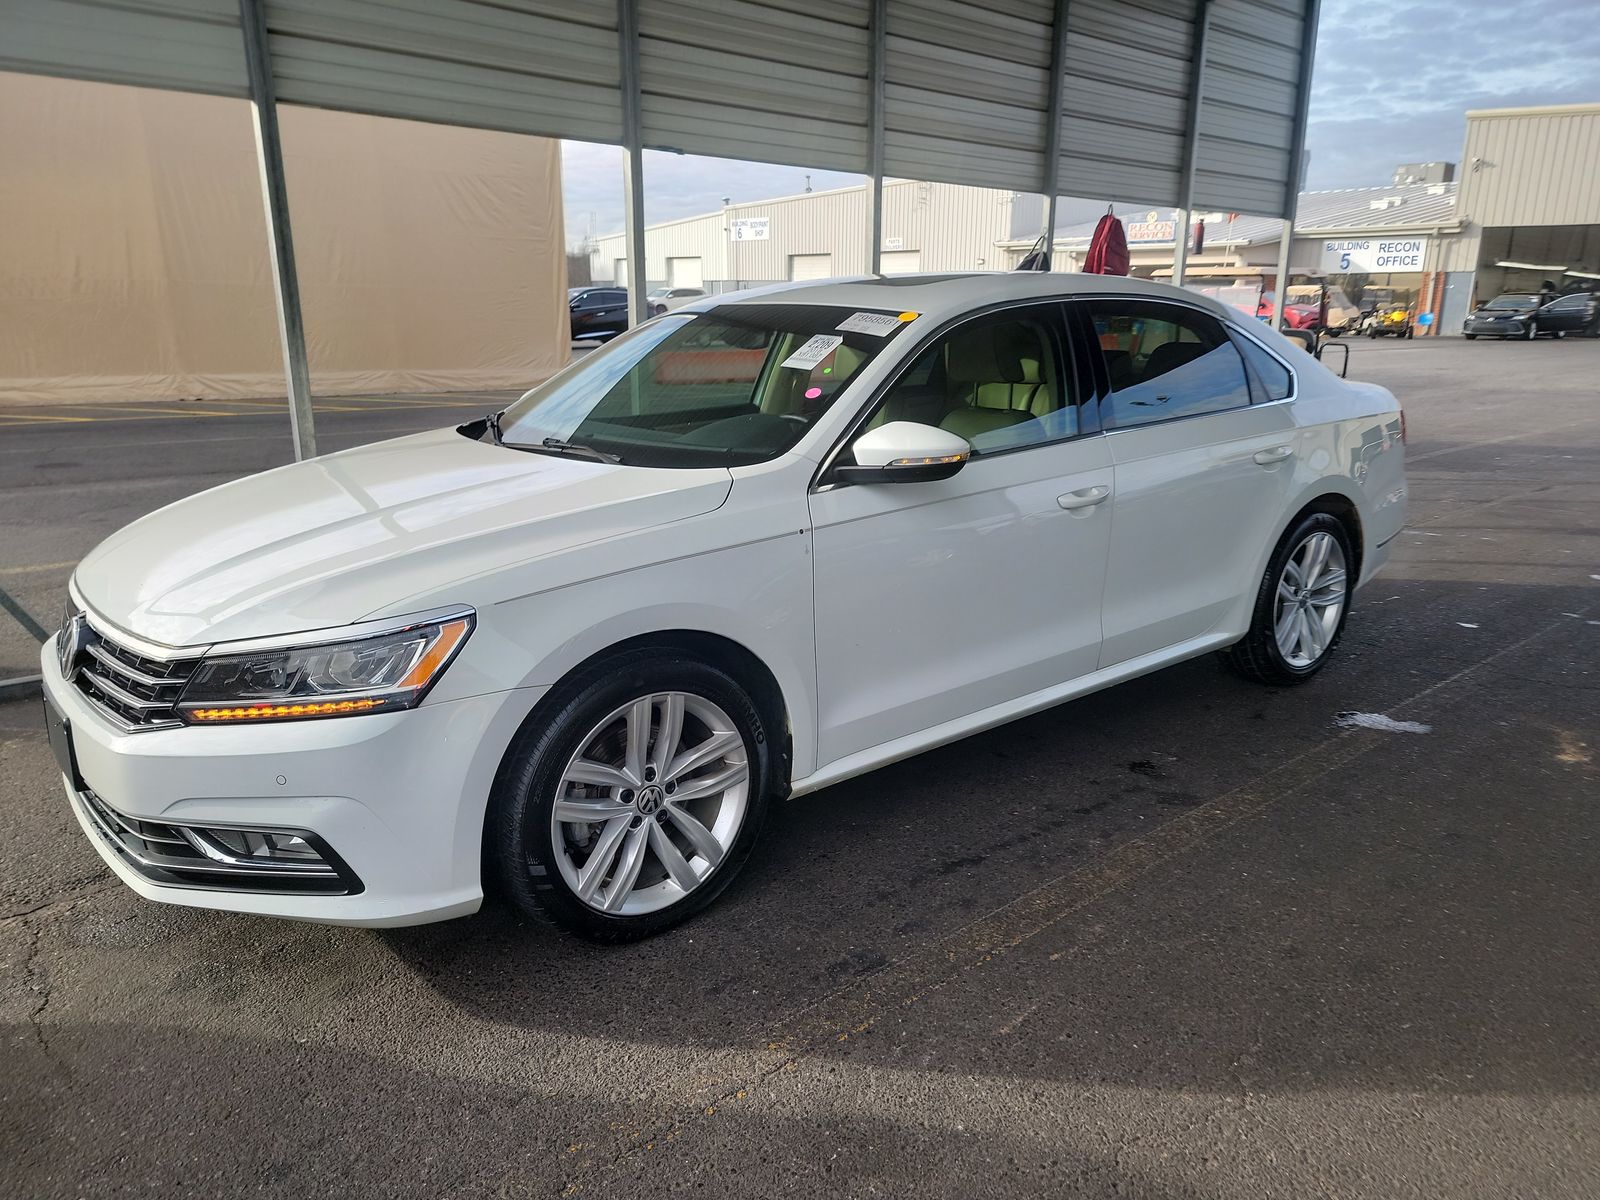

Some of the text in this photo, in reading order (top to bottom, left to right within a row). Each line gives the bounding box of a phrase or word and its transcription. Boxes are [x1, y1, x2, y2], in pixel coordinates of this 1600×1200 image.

[1129, 222, 1174, 232] RECON
[737, 228, 742, 239] 6
[1128, 230, 1173, 240] SERVICES
[1326, 241, 1370, 251] BUILDING
[1378, 241, 1421, 254] RECON
[1340, 252, 1351, 270] 5
[1376, 255, 1419, 267] OFFICE
